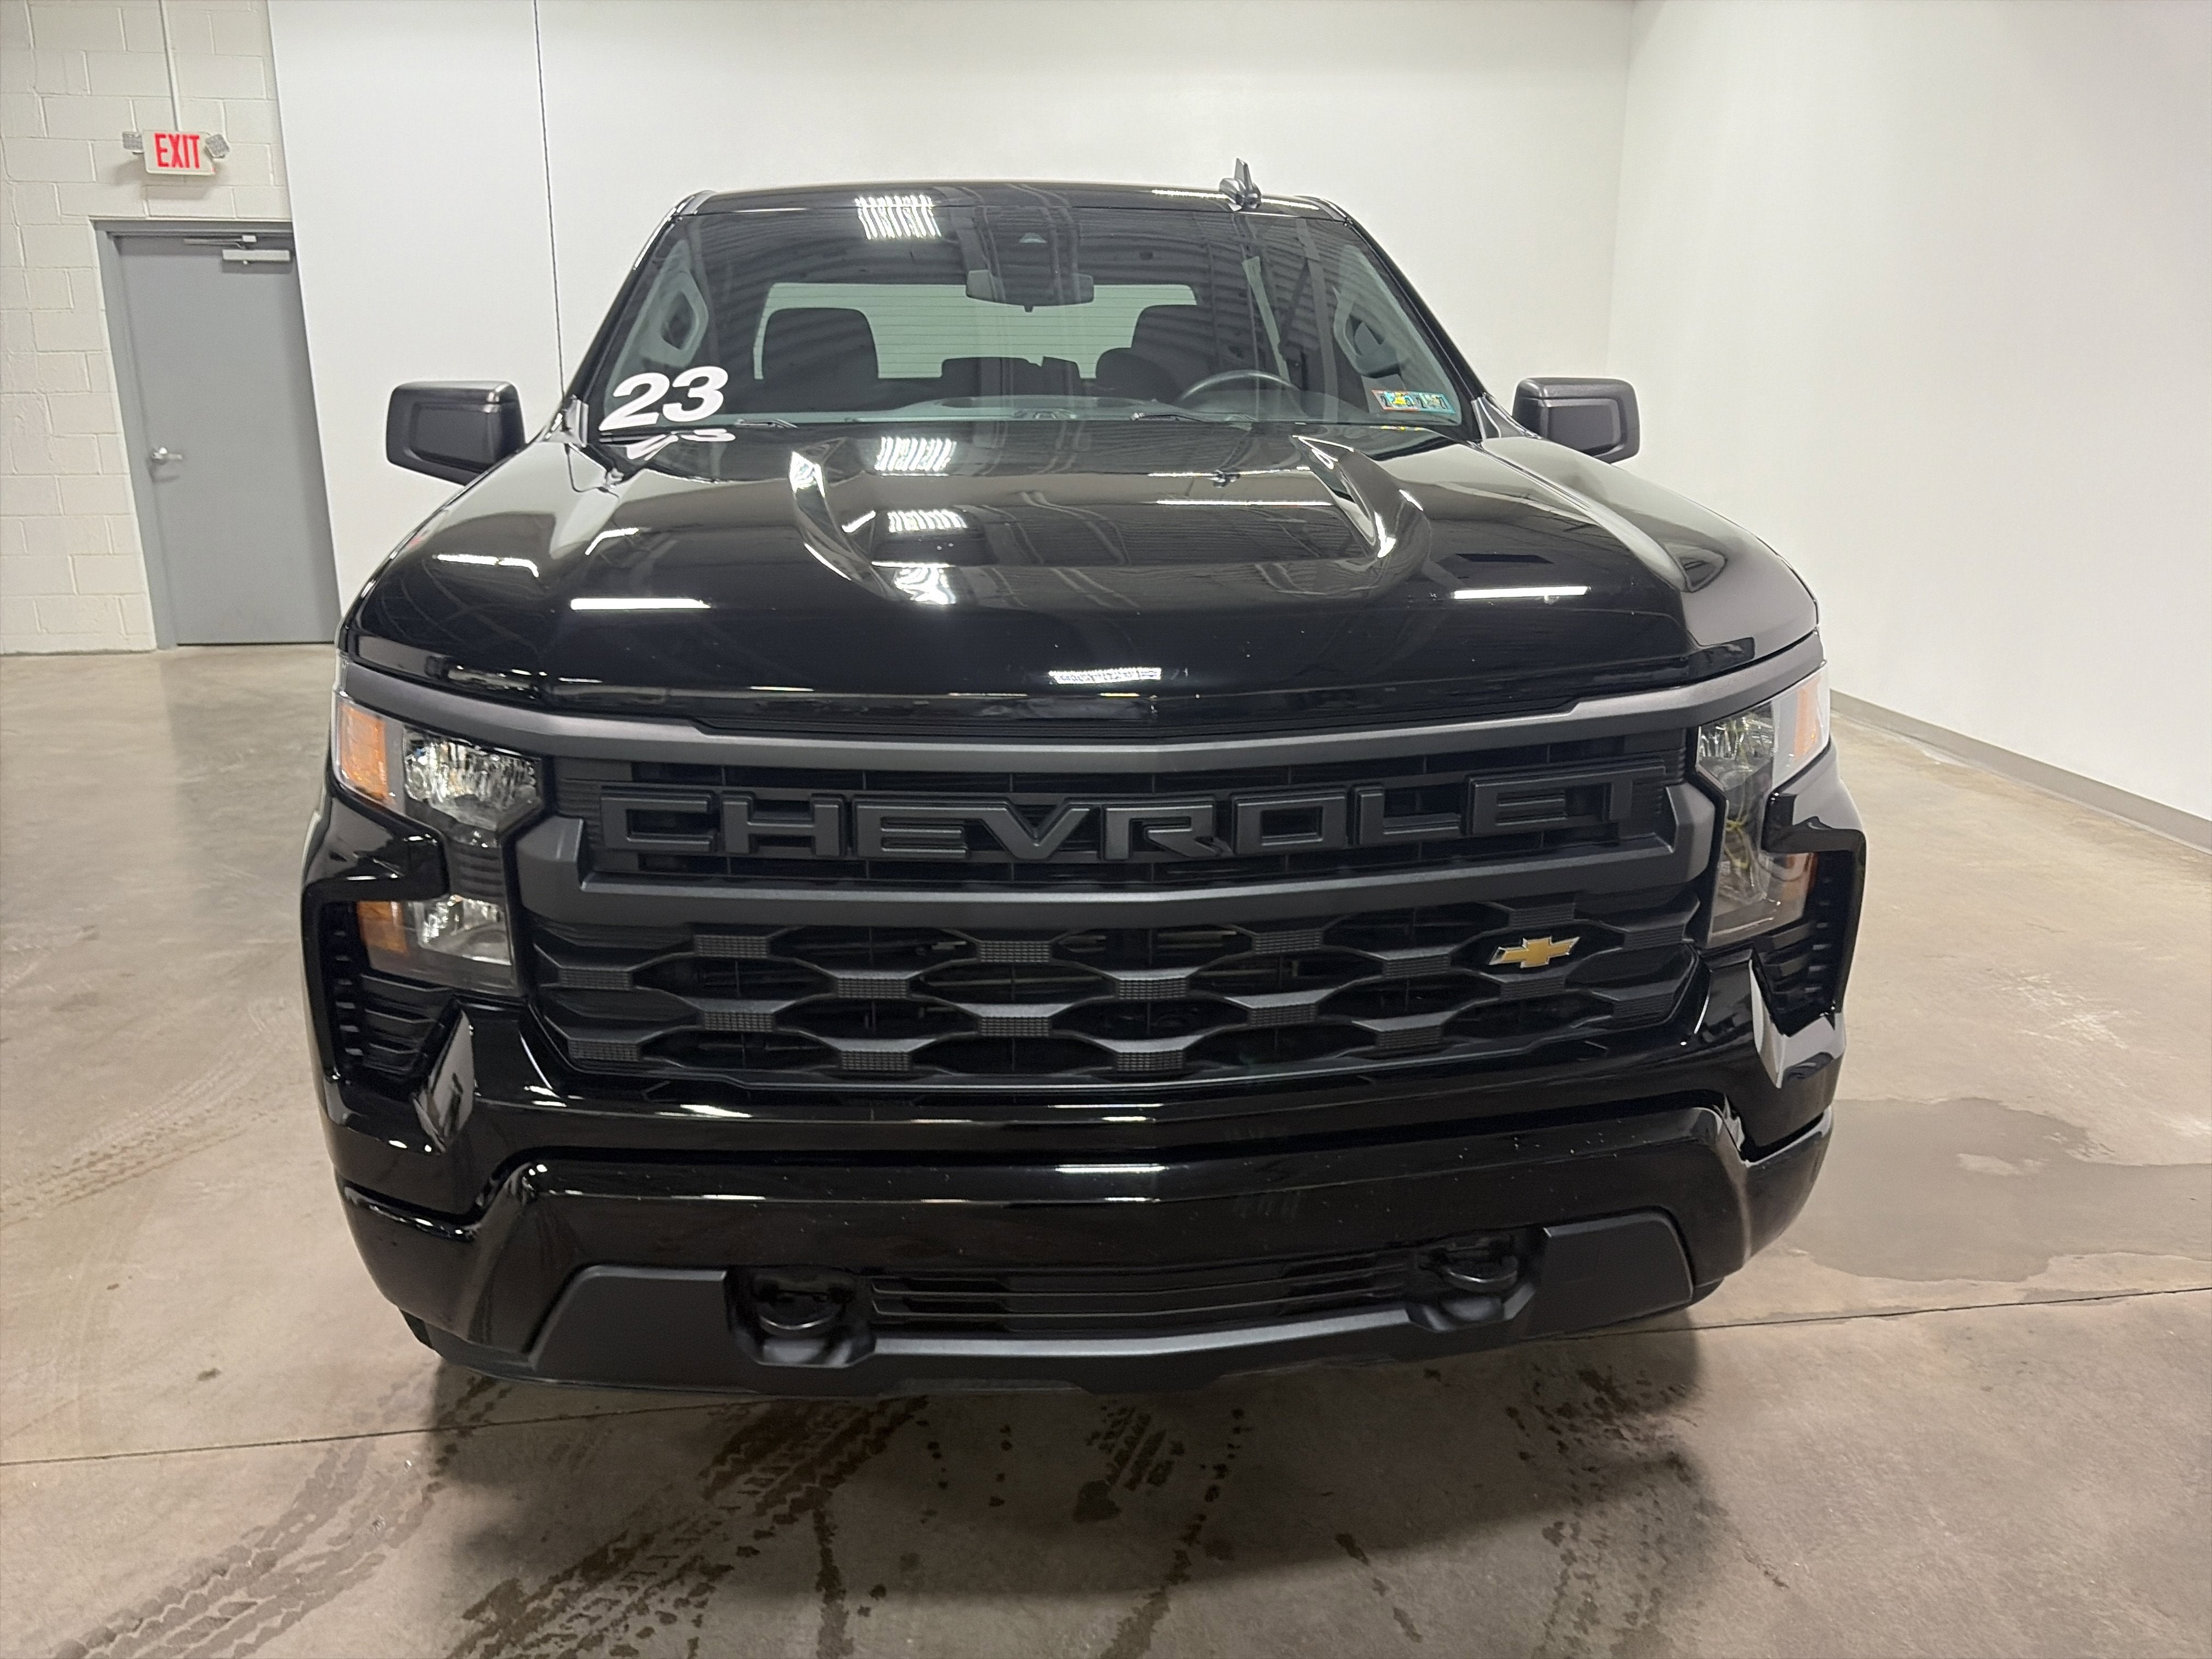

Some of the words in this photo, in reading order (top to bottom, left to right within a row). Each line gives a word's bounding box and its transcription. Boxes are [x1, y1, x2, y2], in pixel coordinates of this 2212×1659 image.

[154, 132, 200, 169] EXIT
[598, 365, 729, 431] 23
[600, 764, 1666, 860] CHEVROLET
